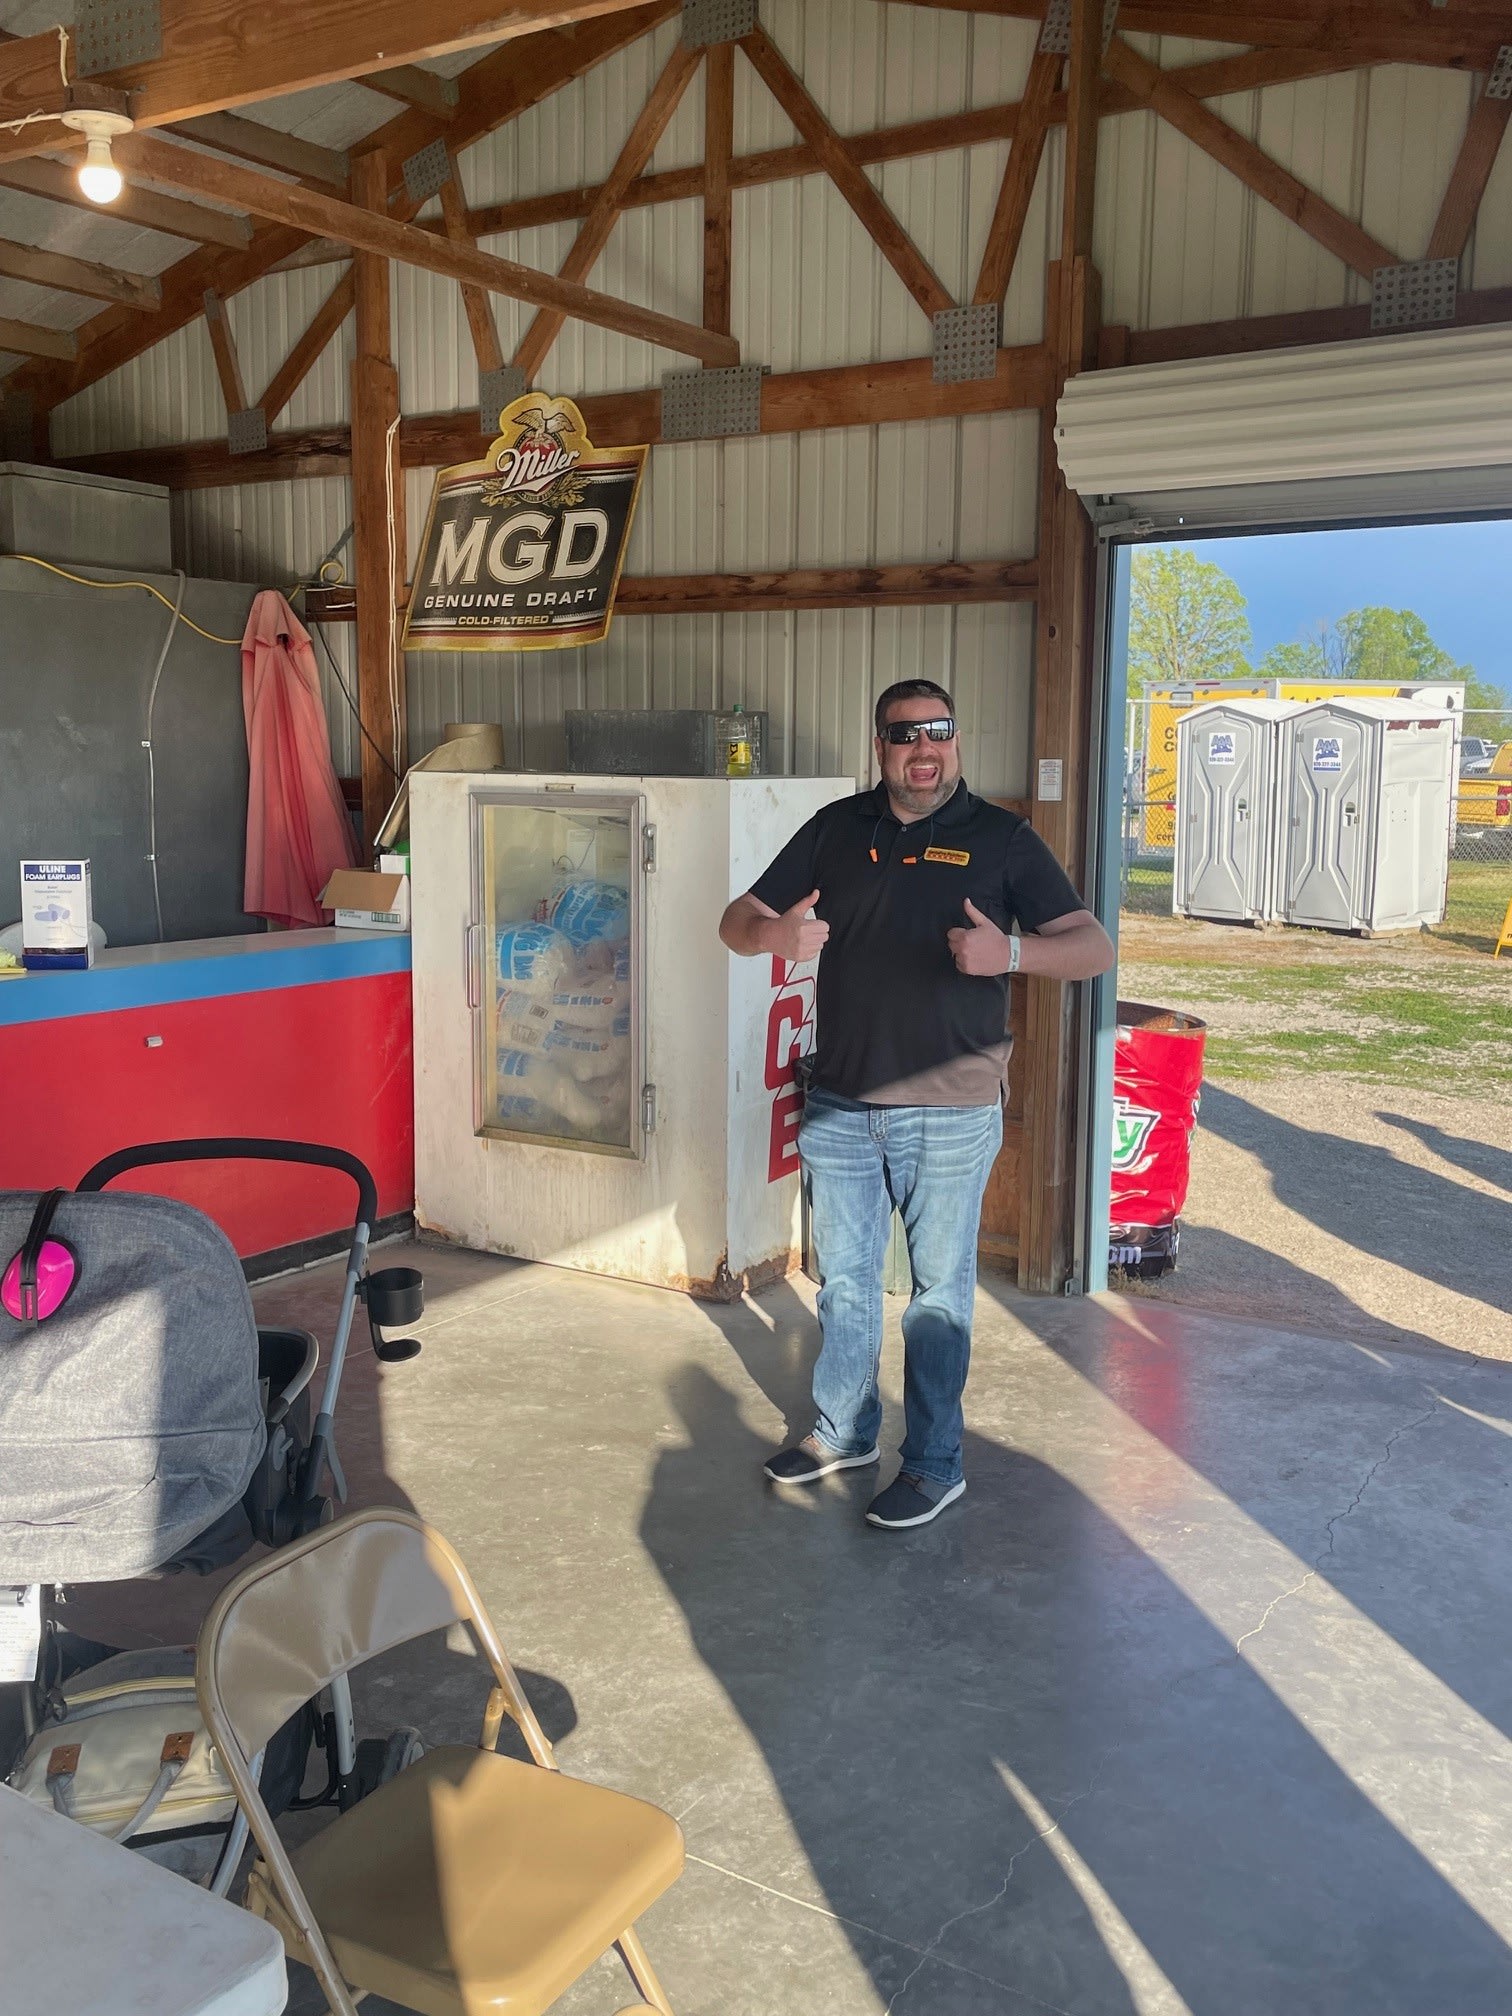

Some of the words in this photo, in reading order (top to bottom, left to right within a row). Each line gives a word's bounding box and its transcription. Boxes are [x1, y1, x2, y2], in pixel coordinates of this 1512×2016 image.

[497, 449, 581, 493] Miller
[429, 508, 609, 587] MGD
[424, 593, 515, 609] GENUINE
[526, 587, 598, 607] DRAFT
[458, 615, 549, 625] COLD-FILTERED
[39, 865, 66, 873] ULINE
